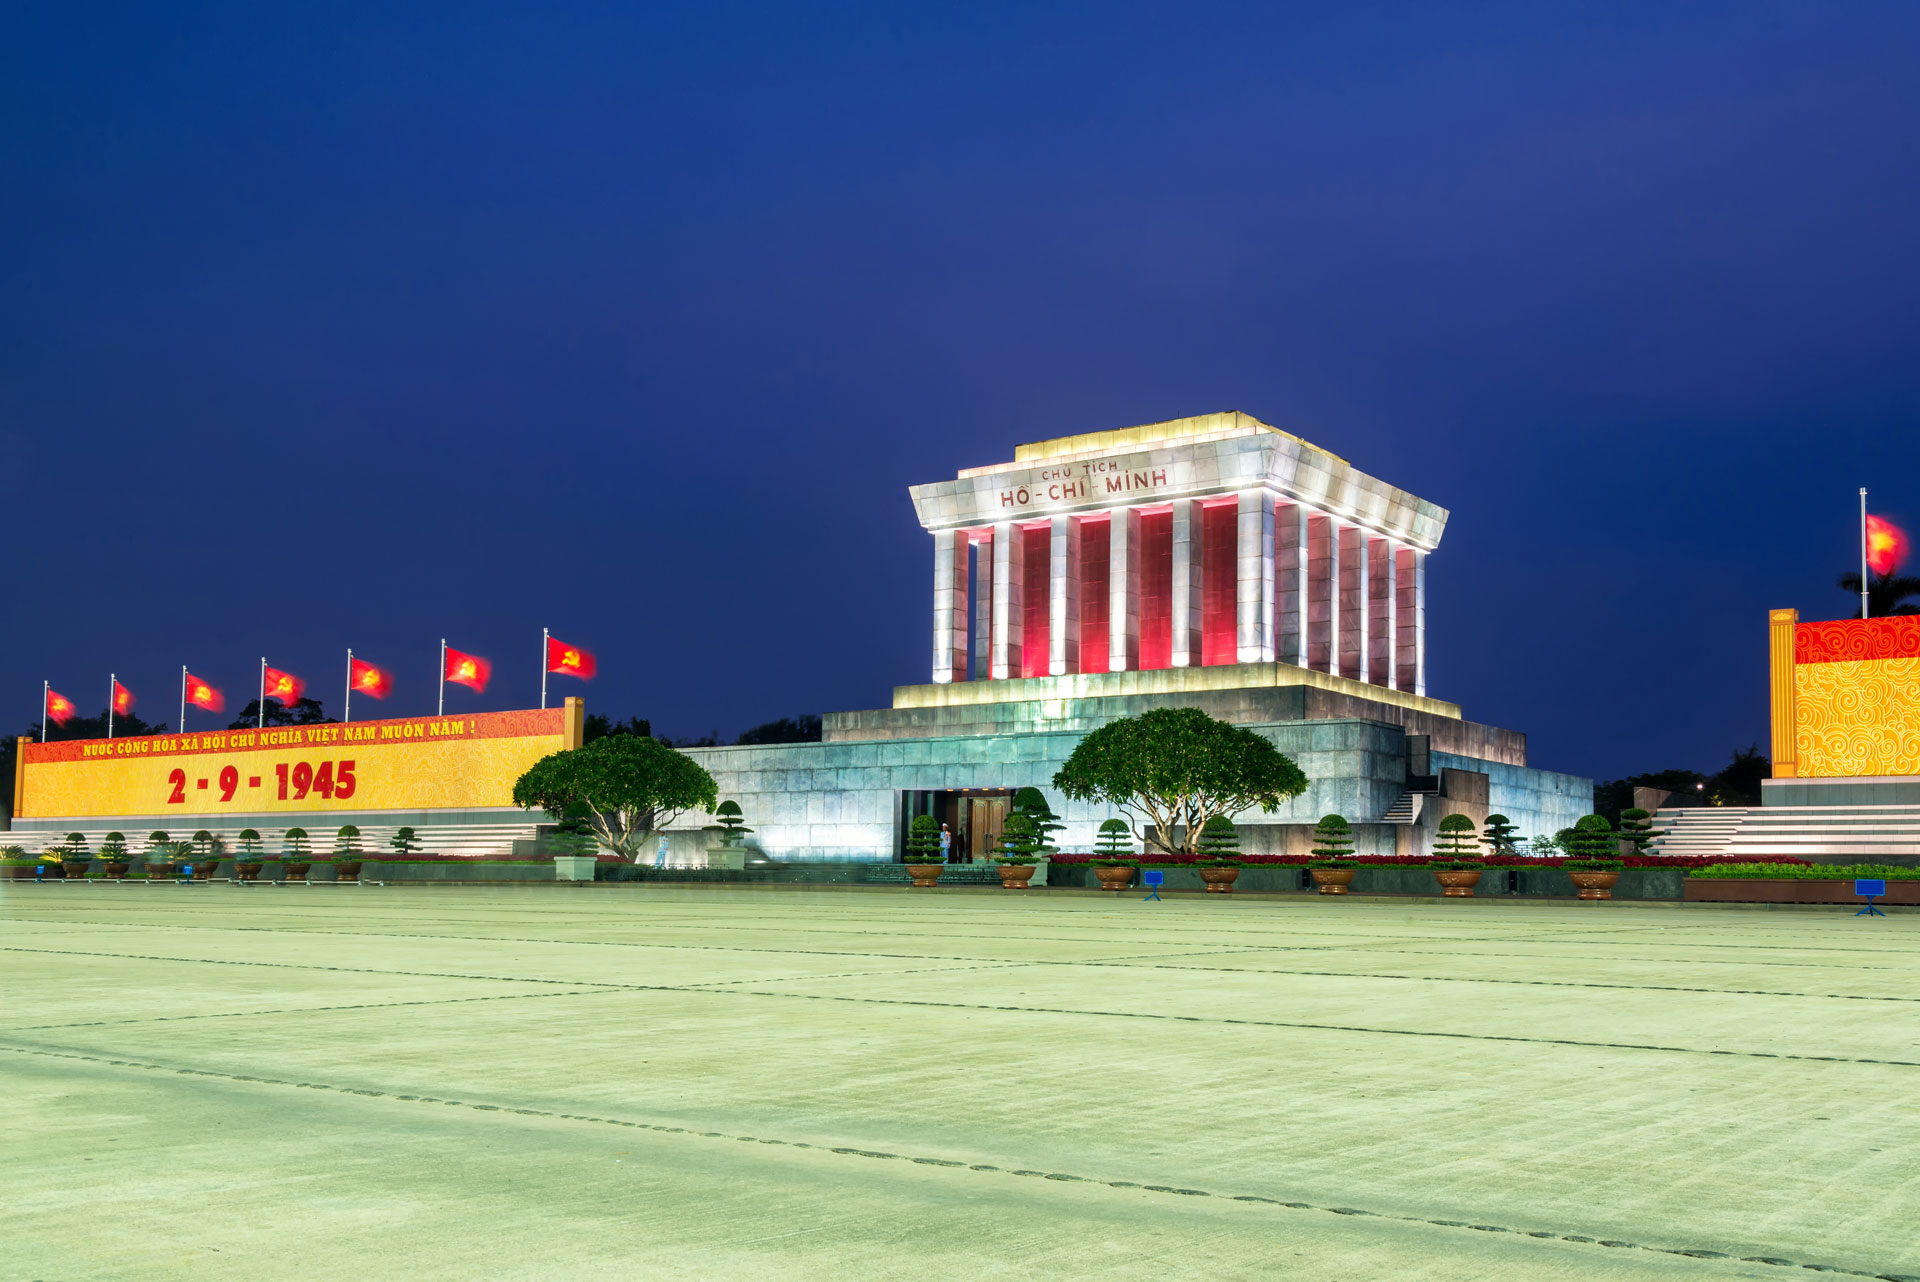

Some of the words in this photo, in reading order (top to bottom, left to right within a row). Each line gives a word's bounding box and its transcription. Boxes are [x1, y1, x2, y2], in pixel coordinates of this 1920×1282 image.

[1041, 464, 1071, 481] CHỦ
[1082, 460, 1118, 478] TỊCH
[117, 739, 149, 757] CỘNG
[152, 738, 177, 752] HÒA
[202, 733, 226, 752] HỘI
[230, 730, 256, 748] CHỦ
[307, 725, 339, 745] VIỆT
[343, 726, 376, 741] NAM
[381, 721, 425, 740] MUÔN
[430, 718, 464, 736] NĂM
[275, 760, 356, 800] 1945
